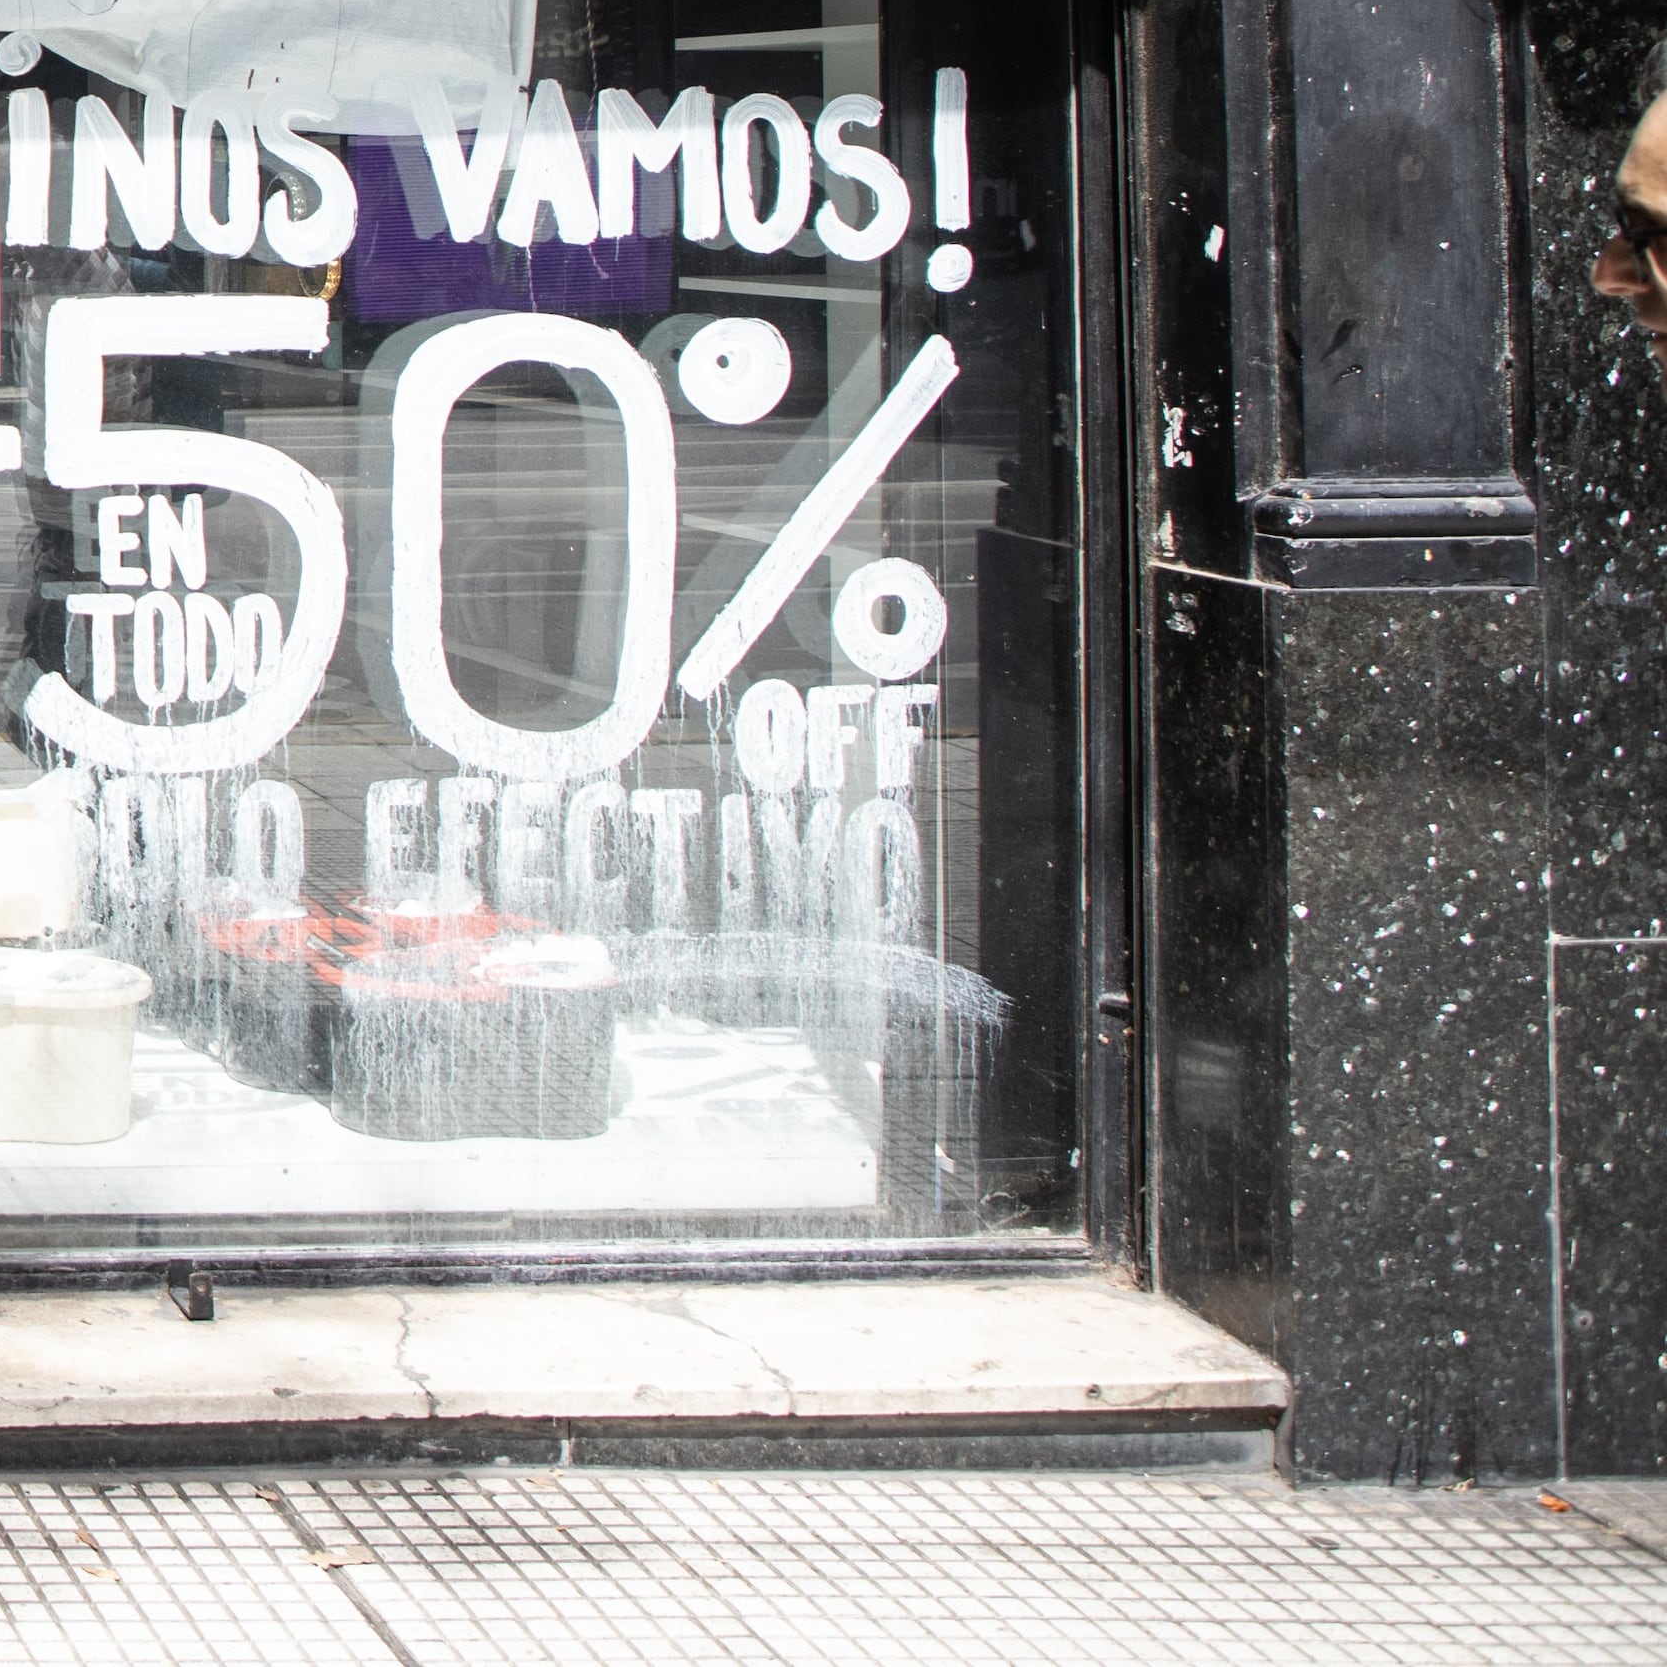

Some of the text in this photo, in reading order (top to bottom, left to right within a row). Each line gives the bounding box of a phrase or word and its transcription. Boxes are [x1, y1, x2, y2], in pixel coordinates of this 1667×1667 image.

[409, 66, 973, 293] VAMOS!
[98, 493, 208, 591] EN
[65, 592, 285, 709] TODO
[736, 677, 940, 793] OFF
[365, 774, 924, 932] EFECTIVO
